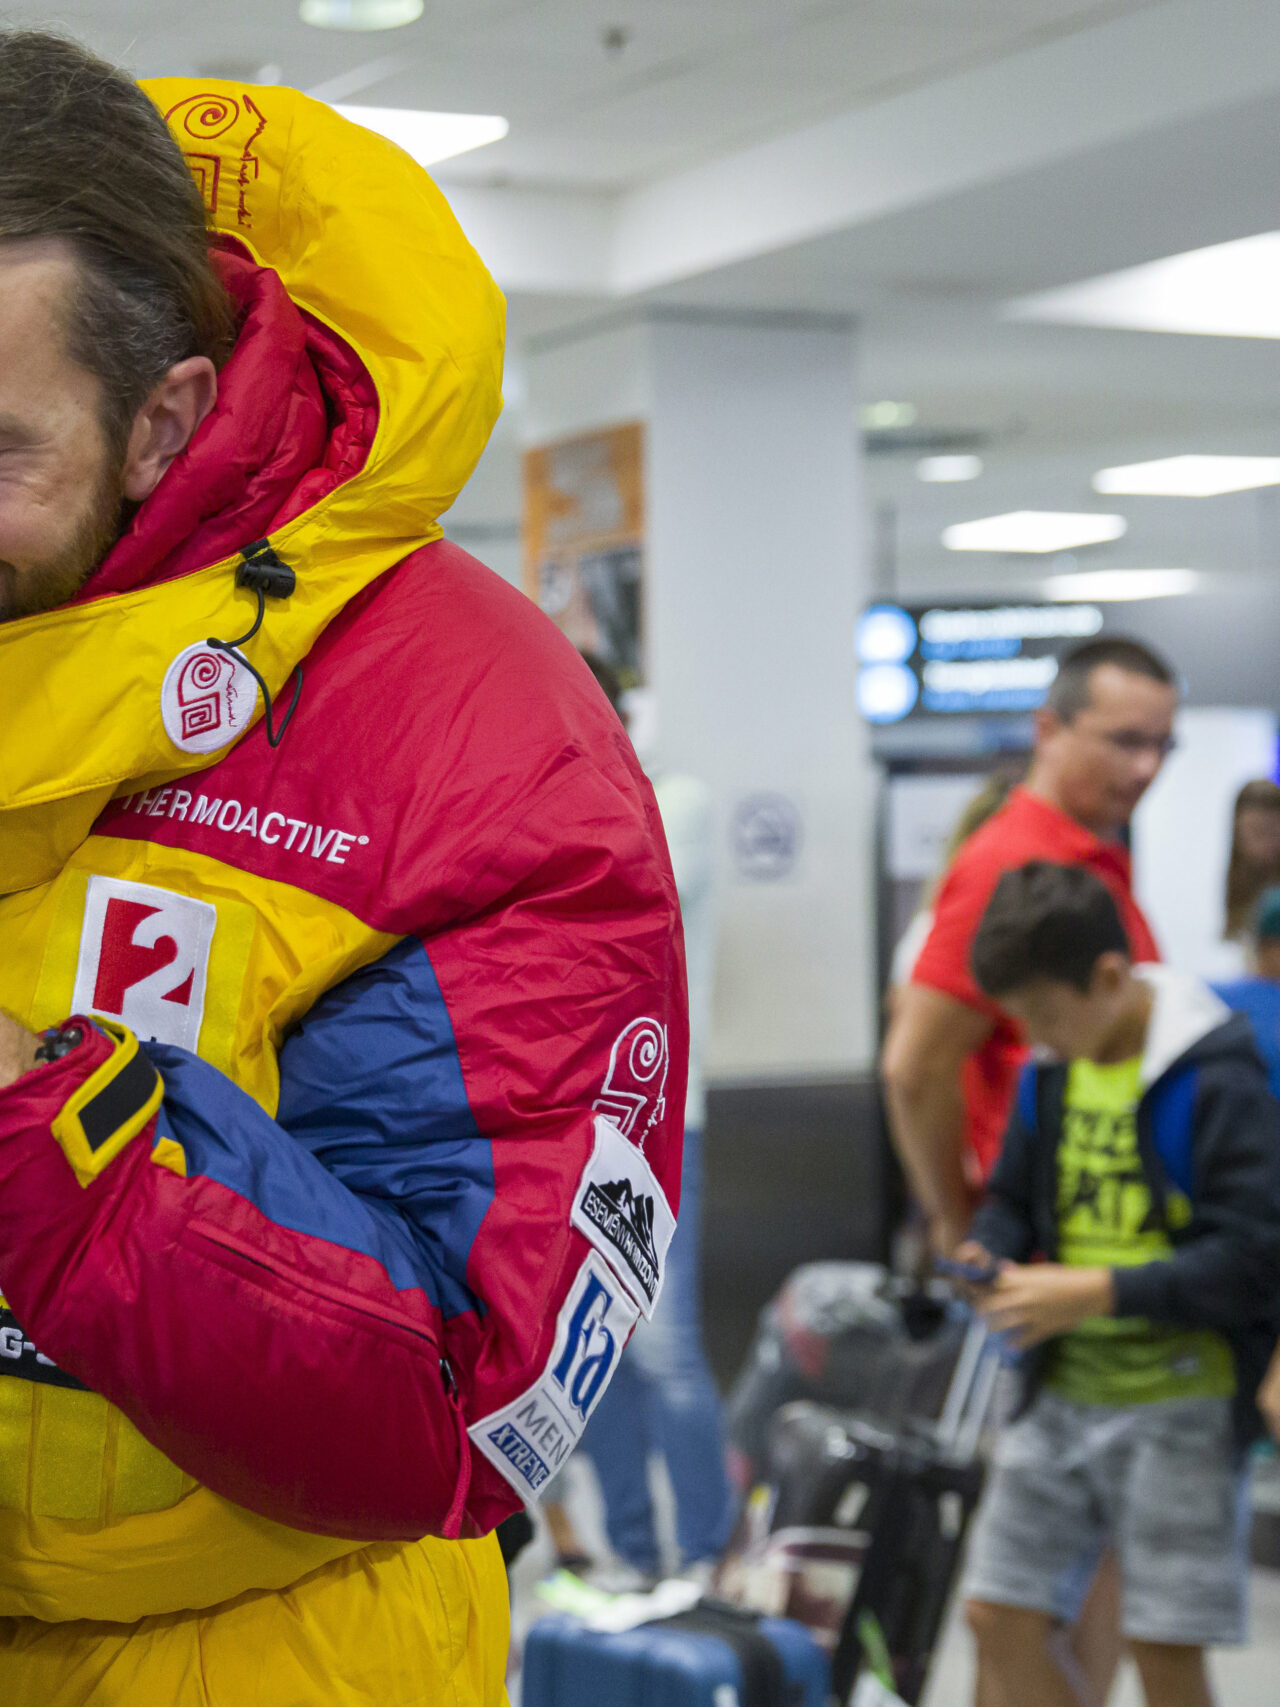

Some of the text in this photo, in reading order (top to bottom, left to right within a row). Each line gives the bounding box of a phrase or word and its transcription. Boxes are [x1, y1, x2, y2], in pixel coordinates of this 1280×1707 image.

[551, 1269, 615, 1422] Fa
[489, 1424, 548, 1488] XTREME
[516, 1400, 570, 1466] MEN
